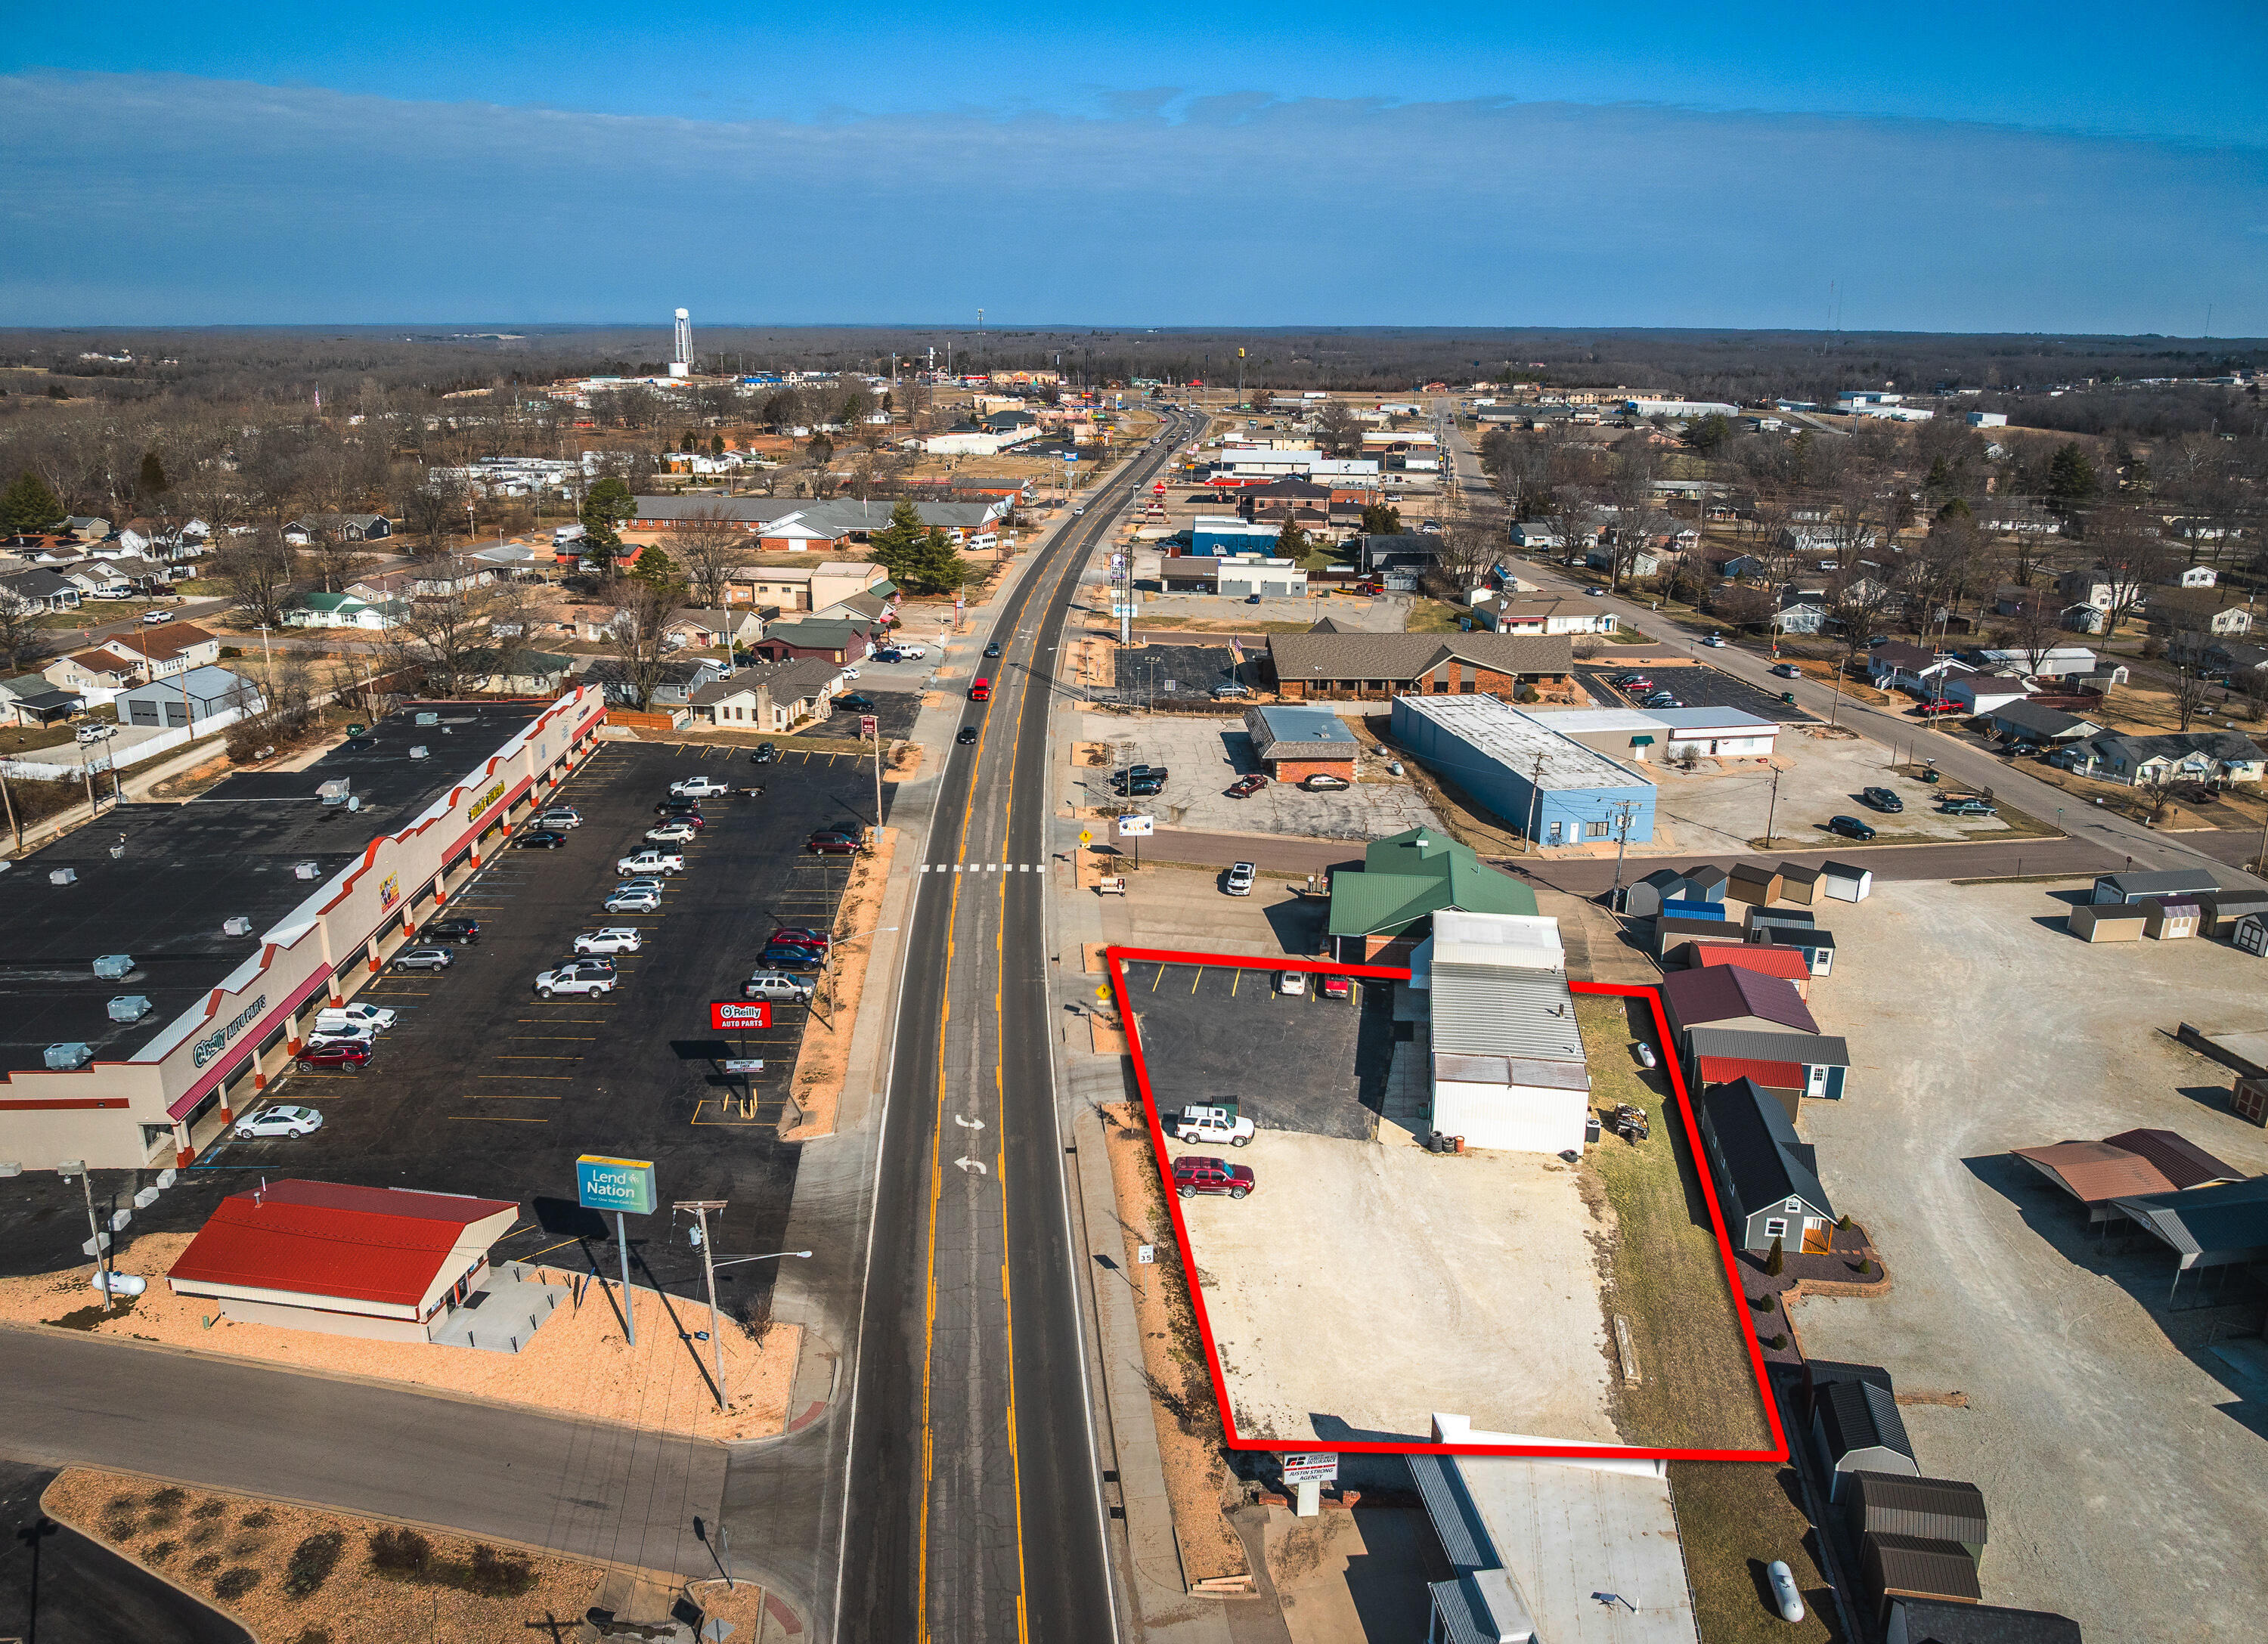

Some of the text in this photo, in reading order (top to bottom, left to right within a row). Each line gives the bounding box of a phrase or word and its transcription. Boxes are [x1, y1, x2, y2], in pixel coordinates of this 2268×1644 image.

[720, 1005, 762, 1019] O'Reilly
[194, 995, 267, 1068] O'Reilly AUTO PARTS
[593, 1169, 626, 1184] Lend
[587, 1181, 635, 1198] Nation
